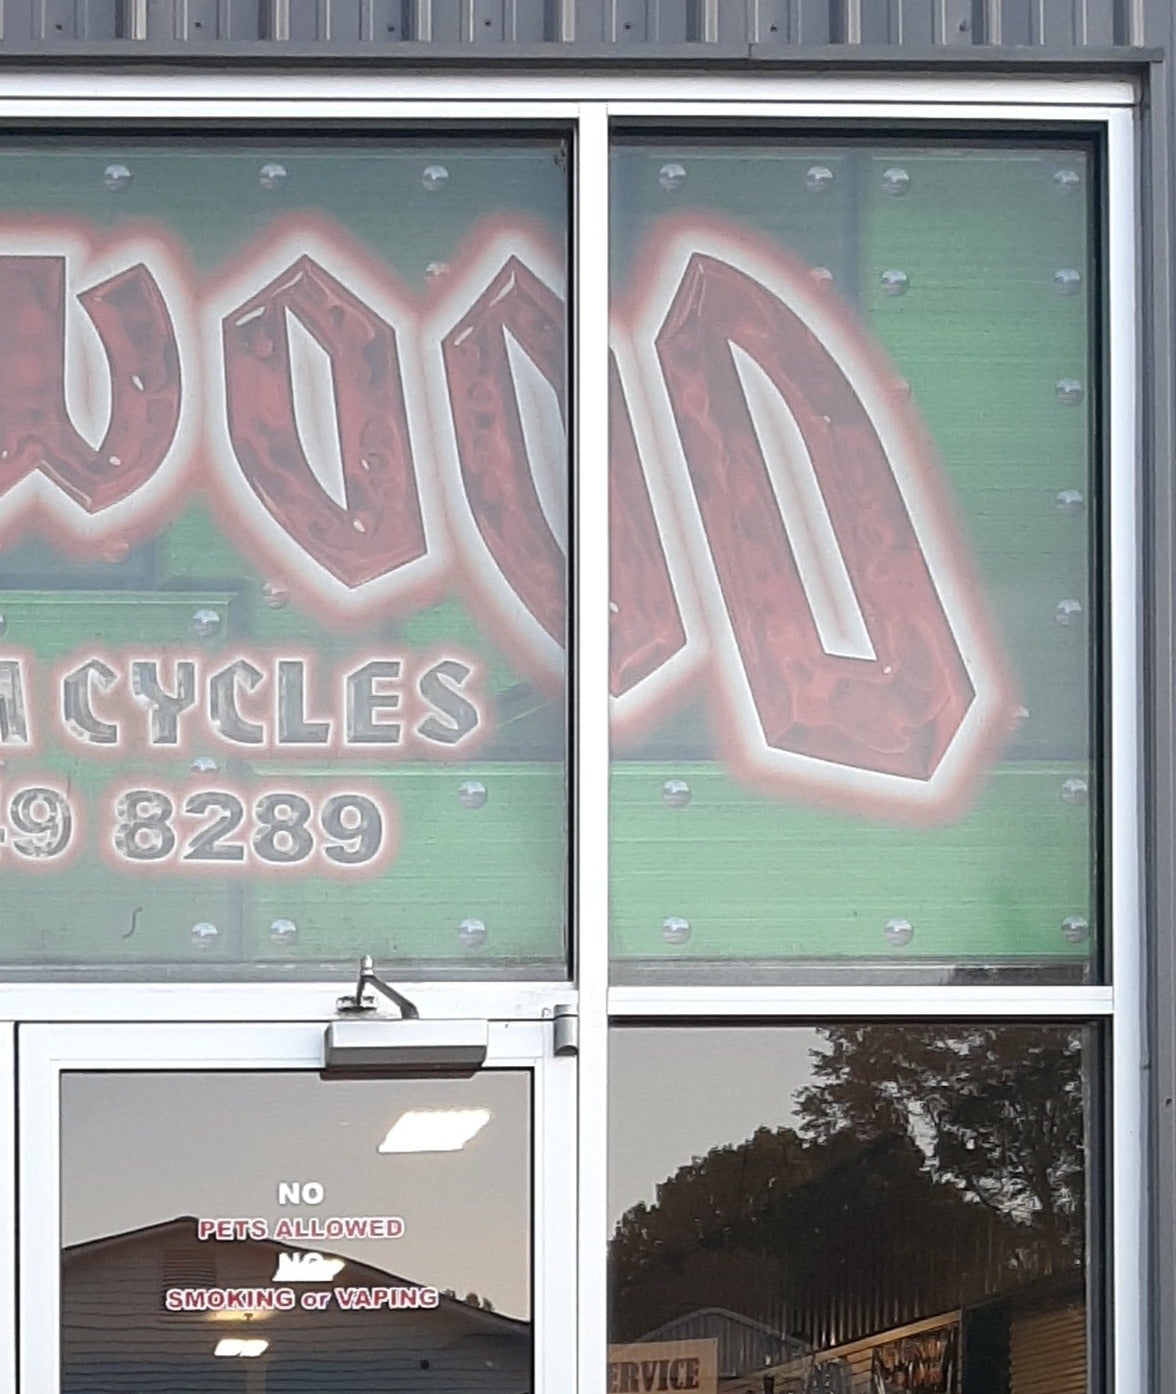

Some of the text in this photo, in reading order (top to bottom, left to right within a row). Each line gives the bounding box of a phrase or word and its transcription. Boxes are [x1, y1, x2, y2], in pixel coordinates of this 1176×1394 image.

[61, 657, 481, 747] CYCLES
[112, 787, 385, 864] 8289
[278, 1182, 324, 1205] NO
[198, 1217, 405, 1240] PETS ALLOWED
[166, 1286, 439, 1311] SMOKING or VAPING
[609, 1357, 700, 1394] ERVICE
